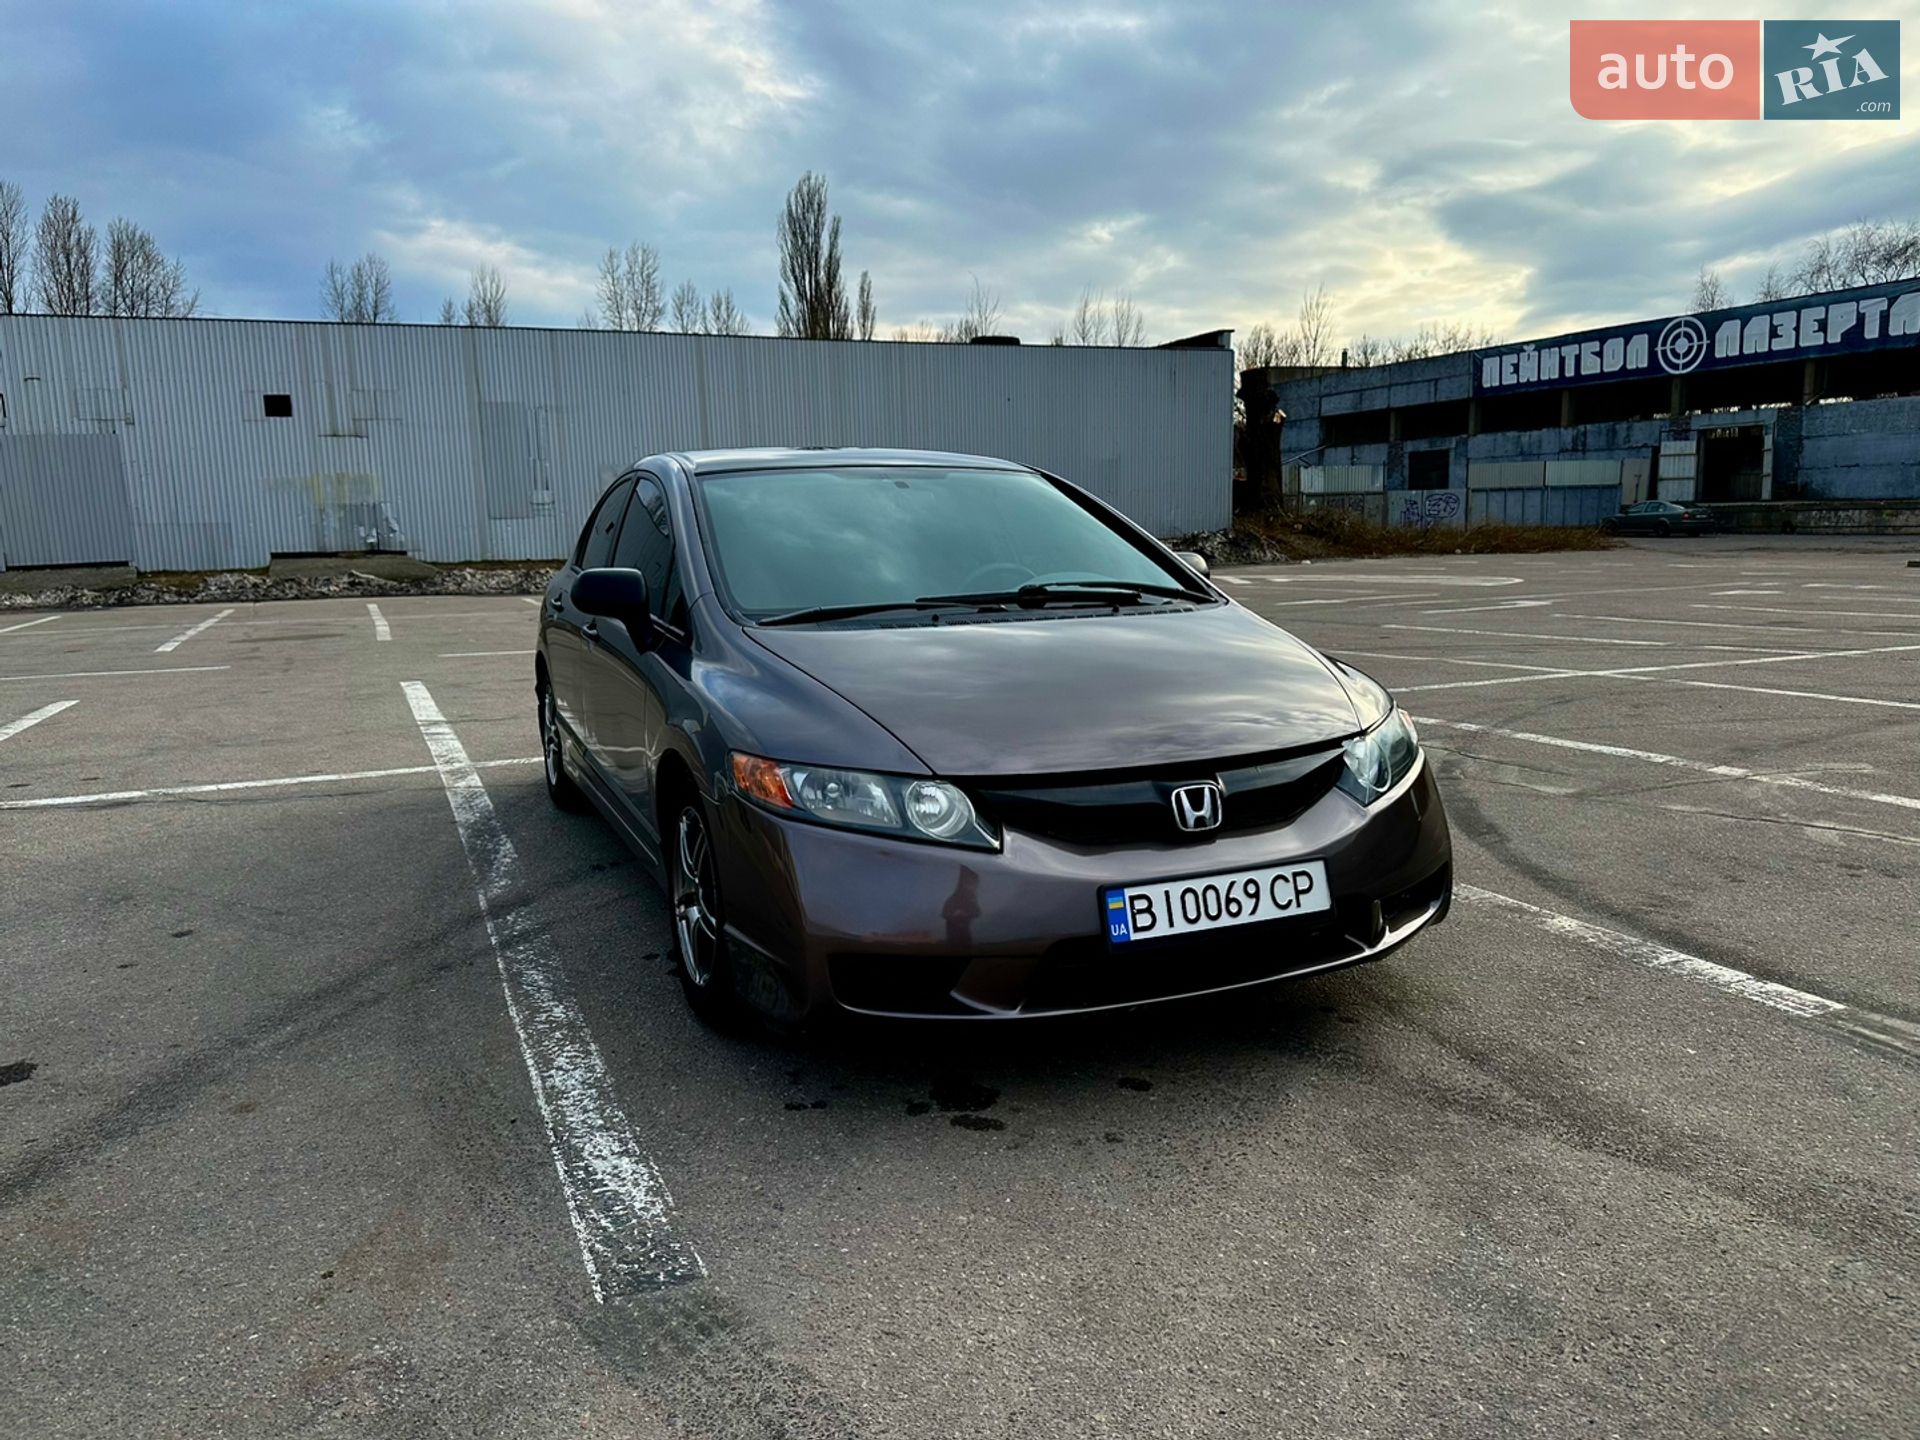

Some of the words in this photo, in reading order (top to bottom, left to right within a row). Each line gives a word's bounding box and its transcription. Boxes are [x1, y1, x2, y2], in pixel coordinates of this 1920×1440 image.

[1482, 333, 1649, 388] ПЕЙНТБОЛ
[1714, 291, 1920, 358] ЛАЗЕРТА
[1110, 923, 1128, 936] UA
